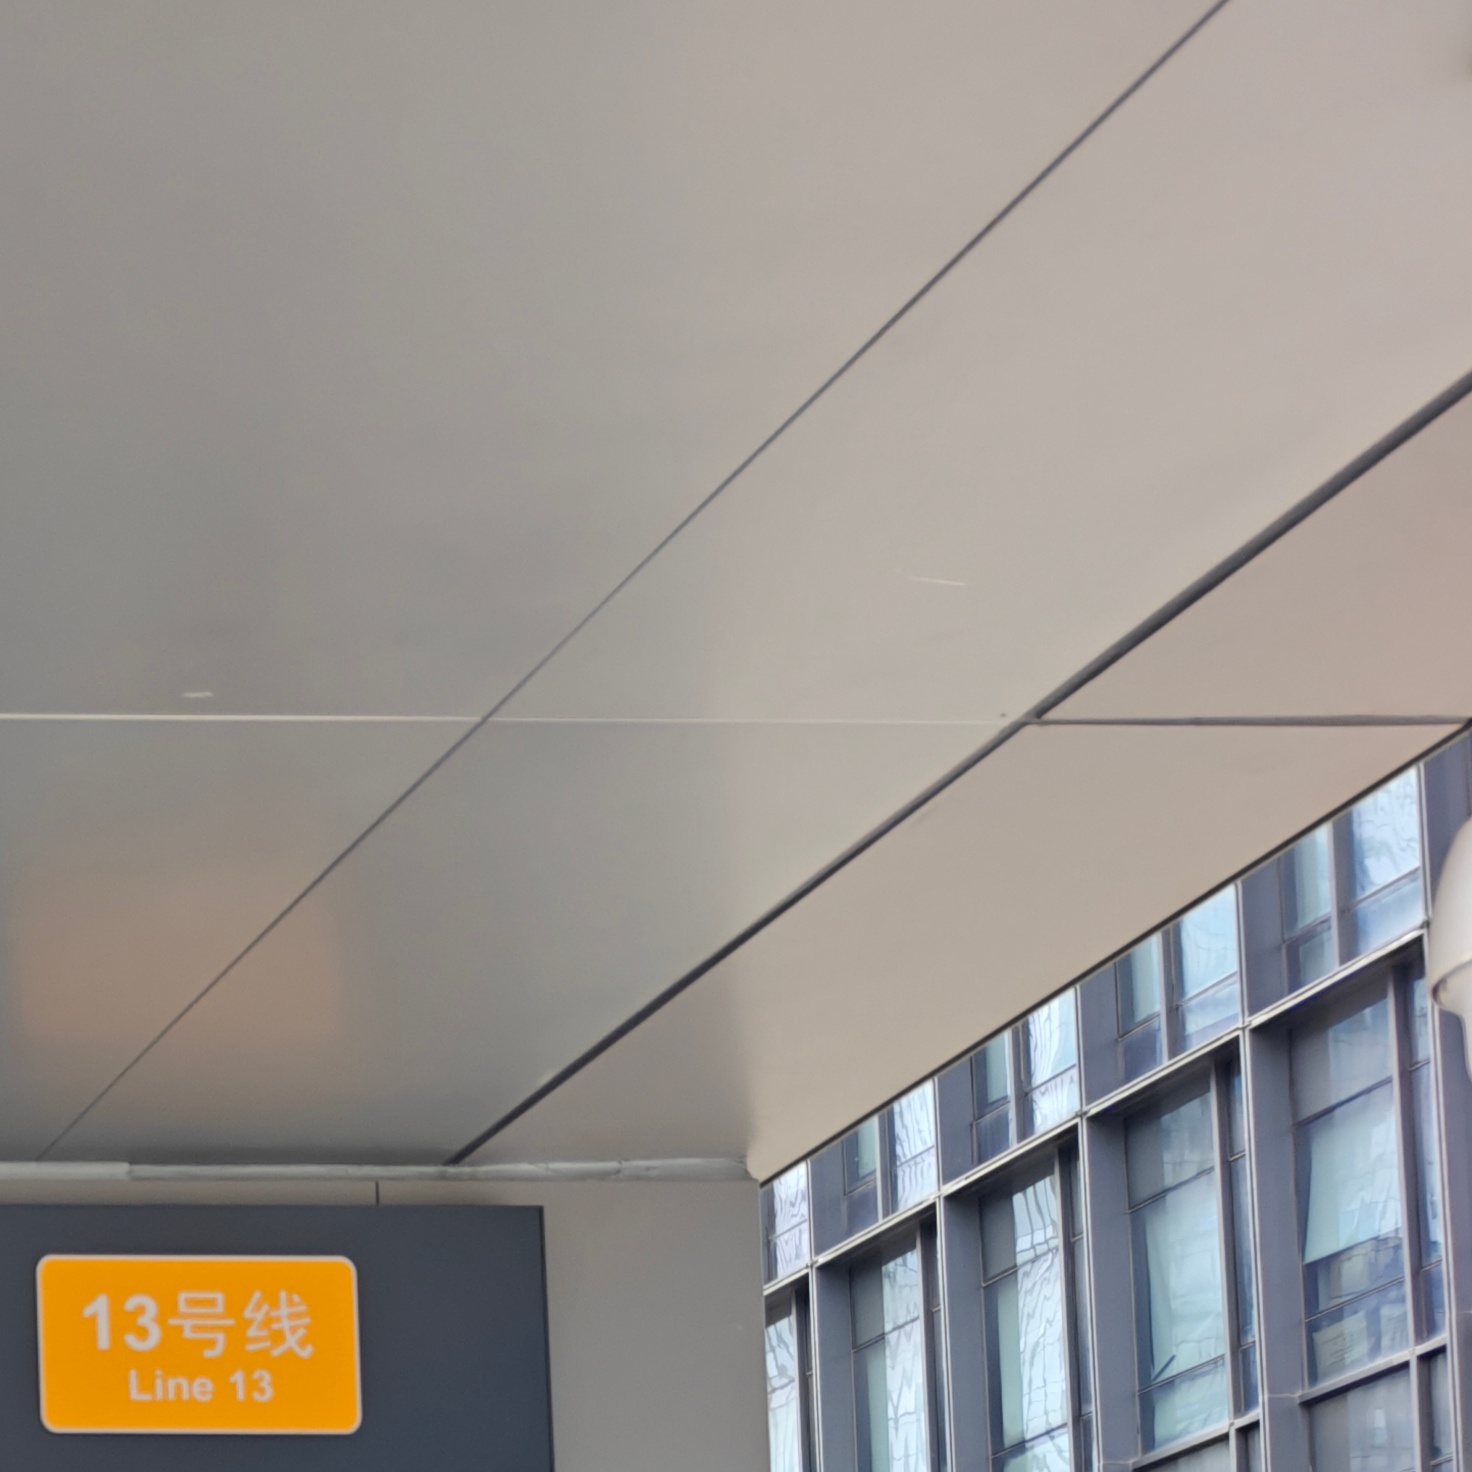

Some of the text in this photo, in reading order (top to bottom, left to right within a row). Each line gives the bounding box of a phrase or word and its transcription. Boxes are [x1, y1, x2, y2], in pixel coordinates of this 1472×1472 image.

[81, 1289, 315, 1360] 13号线
[128, 1369, 275, 1403] Line 13
